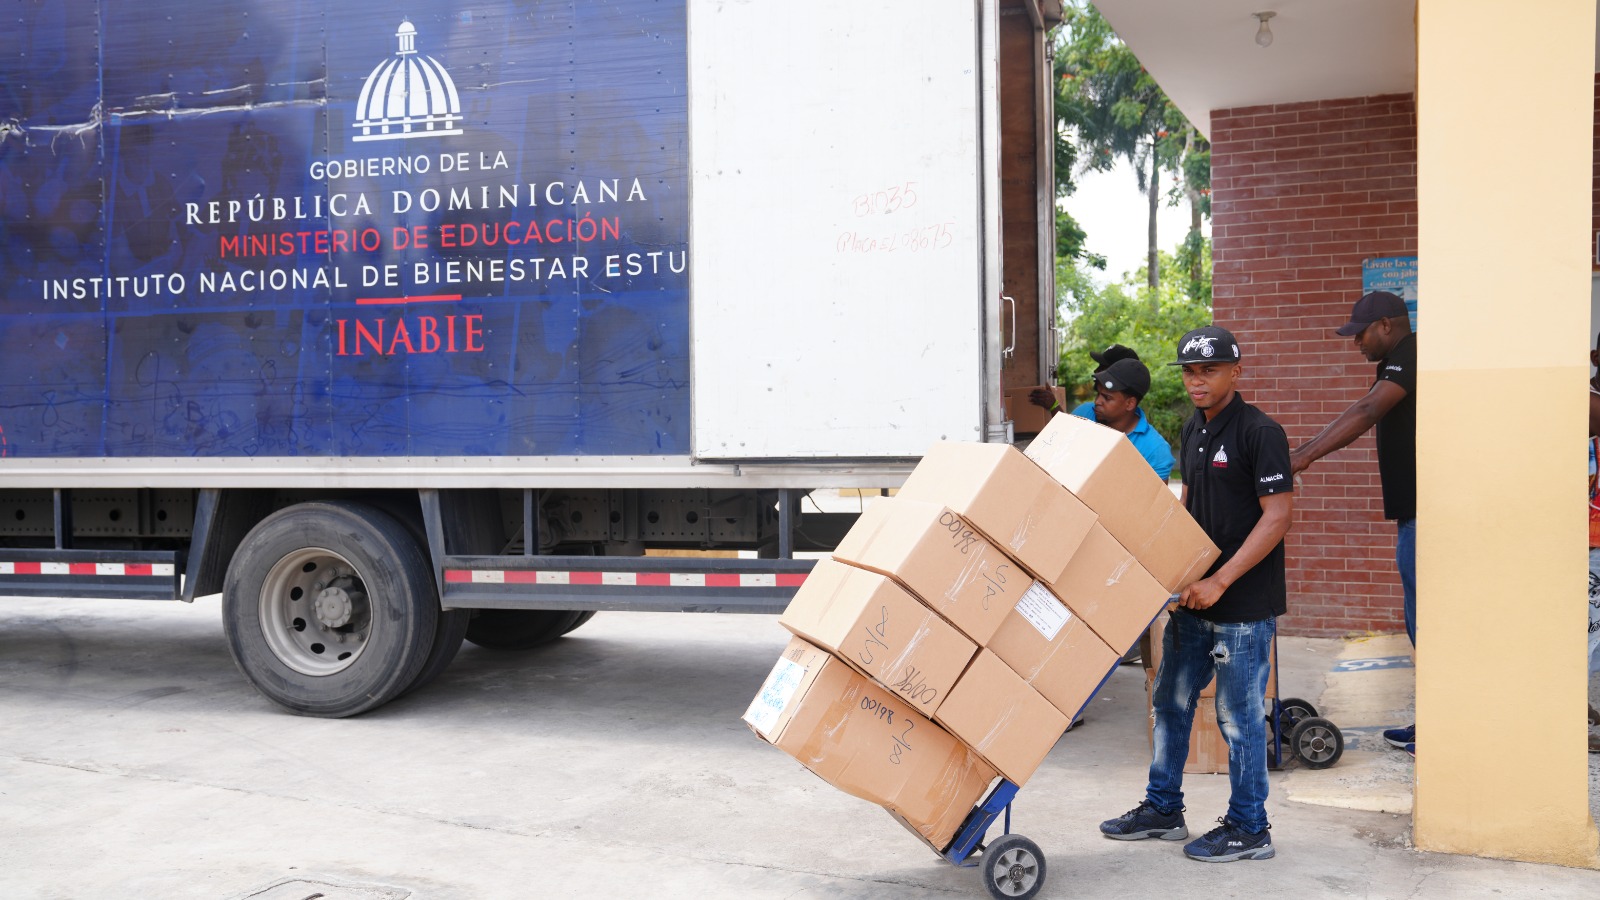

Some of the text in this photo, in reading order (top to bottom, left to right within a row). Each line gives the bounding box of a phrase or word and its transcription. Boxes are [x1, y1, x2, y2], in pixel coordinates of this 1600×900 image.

[309, 150, 509, 180] GOBIERNO DE LA
[185, 177, 648, 225] REPÚBLICA DOMINICANA
[220, 211, 620, 258] MINISTERIO DE EDUCACIÓN
[42, 250, 686, 300] INSTITUTO NACIONAL DE BIENESTAR ESTU
[335, 313, 485, 356] INABIE
[939, 511, 980, 555] 00198
[860, 695, 896, 726] 00198
